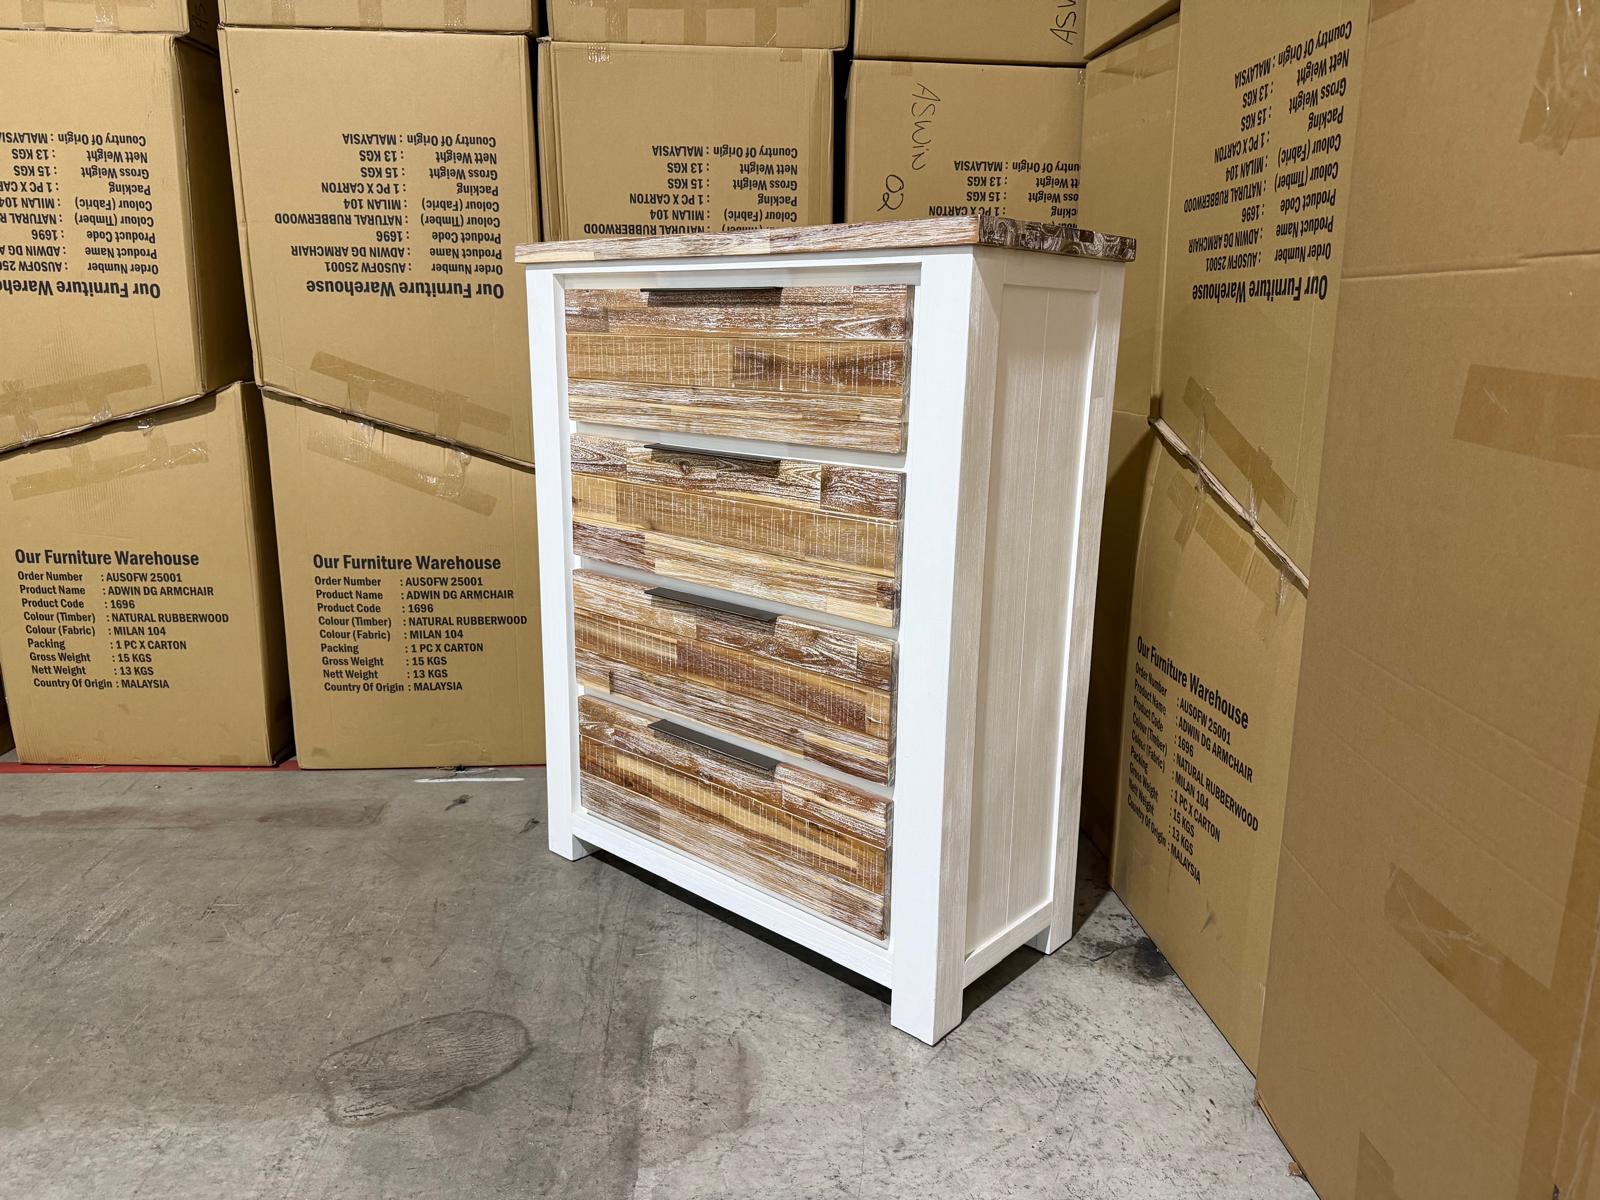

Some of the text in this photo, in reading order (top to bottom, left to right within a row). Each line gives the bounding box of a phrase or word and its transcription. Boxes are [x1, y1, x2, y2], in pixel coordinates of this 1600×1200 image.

[1235, 21, 1352, 88] Country Of Origin MALAYSIA
[342, 133, 496, 147] Country Of Origin MALAYSIA
[12, 148, 147, 163] Nett Weight 13 KGS
[652, 144, 797, 158] Country Of Origin MALAYSIA
[14, 165, 149, 179] Gross Weight 15 KGS
[667, 162, 797, 175] Nett Weight 13 KGS
[954, 160, 1080, 173] untry Of Origin MALAYSIA
[668, 177, 797, 191] Gross Weight 15 KGS
[967, 176, 1068, 188] Weight 13 KGS
[1184, 162, 1338, 212] Colour (Timber) NATURAL RUBBERWOOD
[344, 198, 499, 212] Colour (Fabric) MILAN 104
[1242, 189, 1336, 222] Product Code 1696
[275, 213, 500, 228] Colour (Timber) NATURAL RUBBERWOOD
[32, 229, 155, 243] Product Code 1696
[376, 231, 501, 244] Product Code 1696
[1189, 216, 1333, 253] Product Name ADWIN DG ARMCHAIR
[291, 246, 502, 259] Product Name ADWIN DG ARMCHAIR
[1206, 243, 1331, 271] Order Number AUSOFW 25001
[325, 262, 503, 275] Order Number AUSOFW 25001
[57, 281, 160, 298] Our Furniture
[307, 281, 504, 299] Our Furniture Warehouse
[1193, 275, 1327, 303] Our Furniture Warehouse
[15, 549, 199, 565] Our Furniture Warehouse
[313, 554, 501, 569] Our Furniture Warehouse
[18, 571, 182, 582] Order Number AUSOFW 25001
[315, 576, 483, 586] Order Number AUSOFW 25001
[20, 585, 214, 596] Product Name ADWIN DG ARMCHAIR
[316, 590, 513, 599] Product Name ADWIN DG ARMCHAIR
[317, 603, 433, 613] Product Code 1696
[24, 612, 229, 623] Colour (Timber) NATURAL RUBBERWOOD
[319, 616, 527, 628] Colour (Timber) NATURAL RUBBERWOOD
[26, 625, 166, 637] Colour (Fabric) MILAN 104
[321, 643, 483, 654] Packing 1 PC X CARTON
[30, 652, 152, 663] Gross Weight 15 KGS
[32, 665, 153, 676] Nett Weight 13 KGS
[324, 682, 462, 693] Country Of Origin MALAYSIA
[1137, 635, 1249, 729] Our Furniture Warehouse
[1180, 698, 1231, 746] AUSOFW 25001
[1178, 735, 1194, 757] 1696
[1178, 716, 1253, 783] ADWIN DG ARMCHAIR
